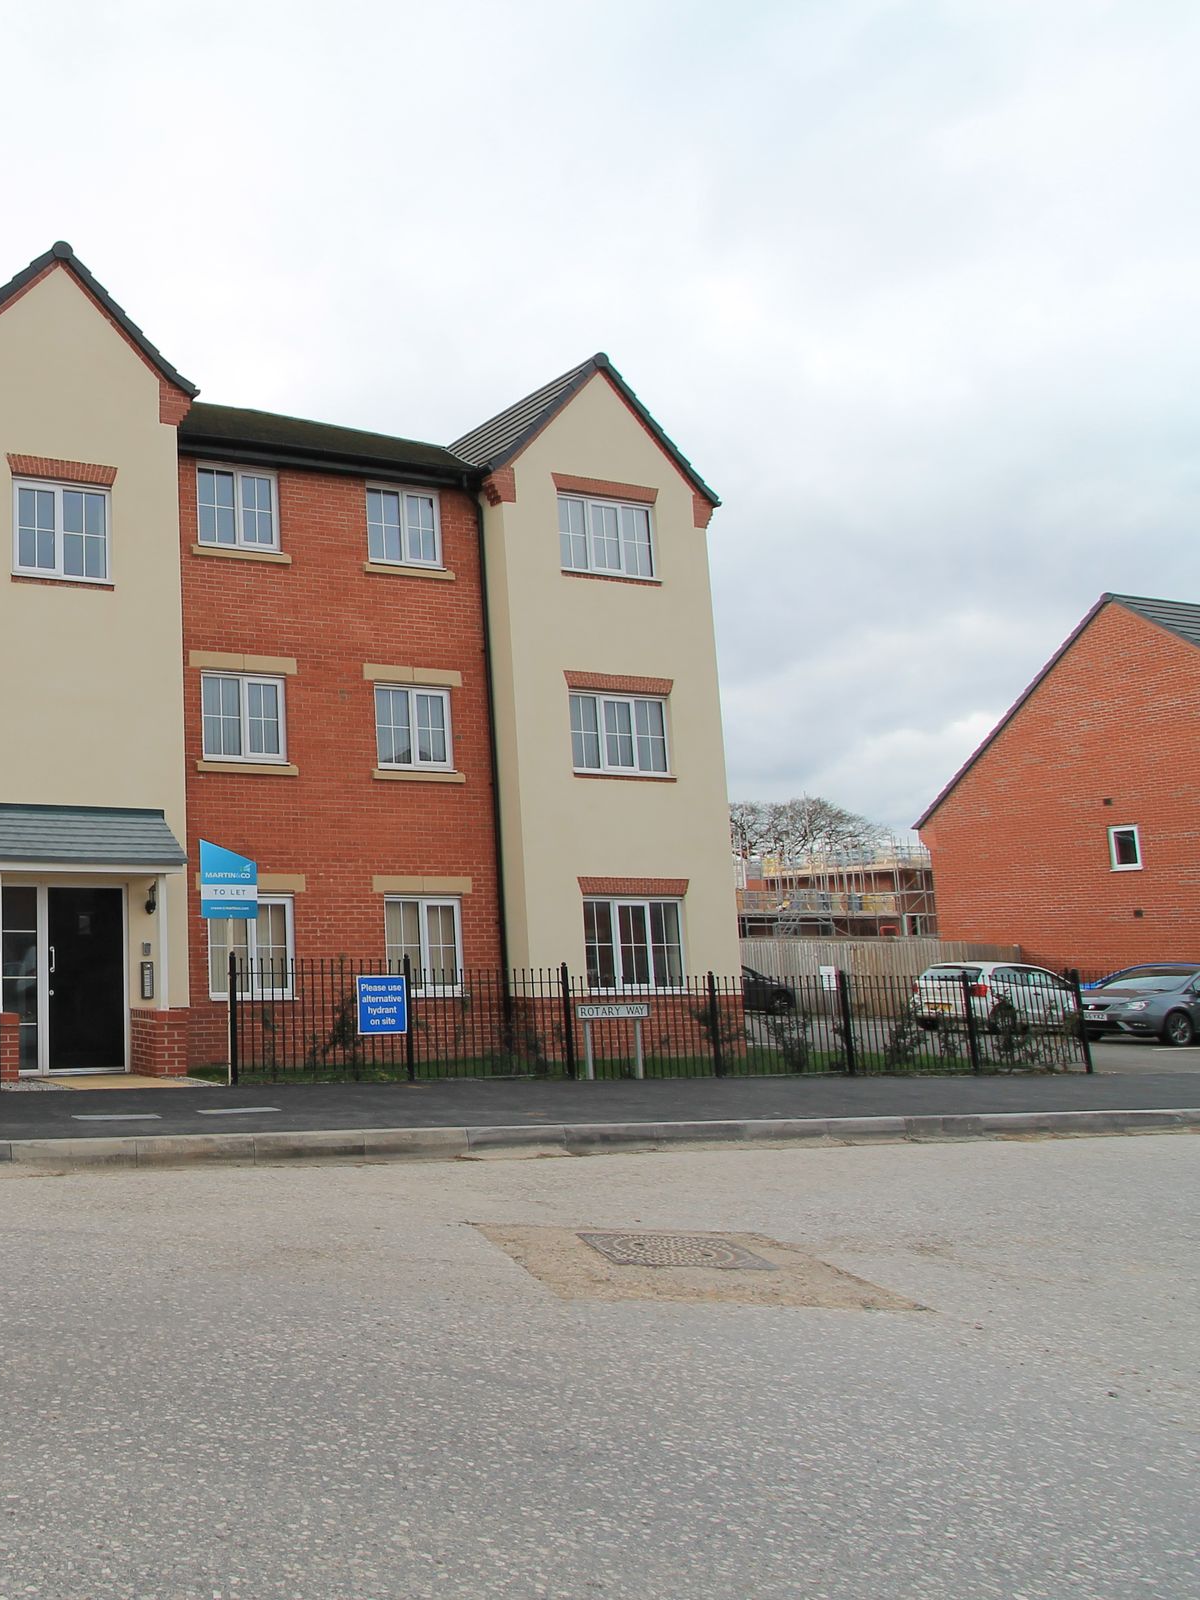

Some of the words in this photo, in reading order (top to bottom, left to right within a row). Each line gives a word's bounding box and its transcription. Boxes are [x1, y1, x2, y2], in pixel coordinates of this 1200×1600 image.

[362, 995, 402, 1003] alternative
[368, 1006, 398, 1016] hydrant
[580, 1007, 620, 1017] ROTARY
[626, 1006, 644, 1016] WAY
[382, 1017, 396, 1025] site
